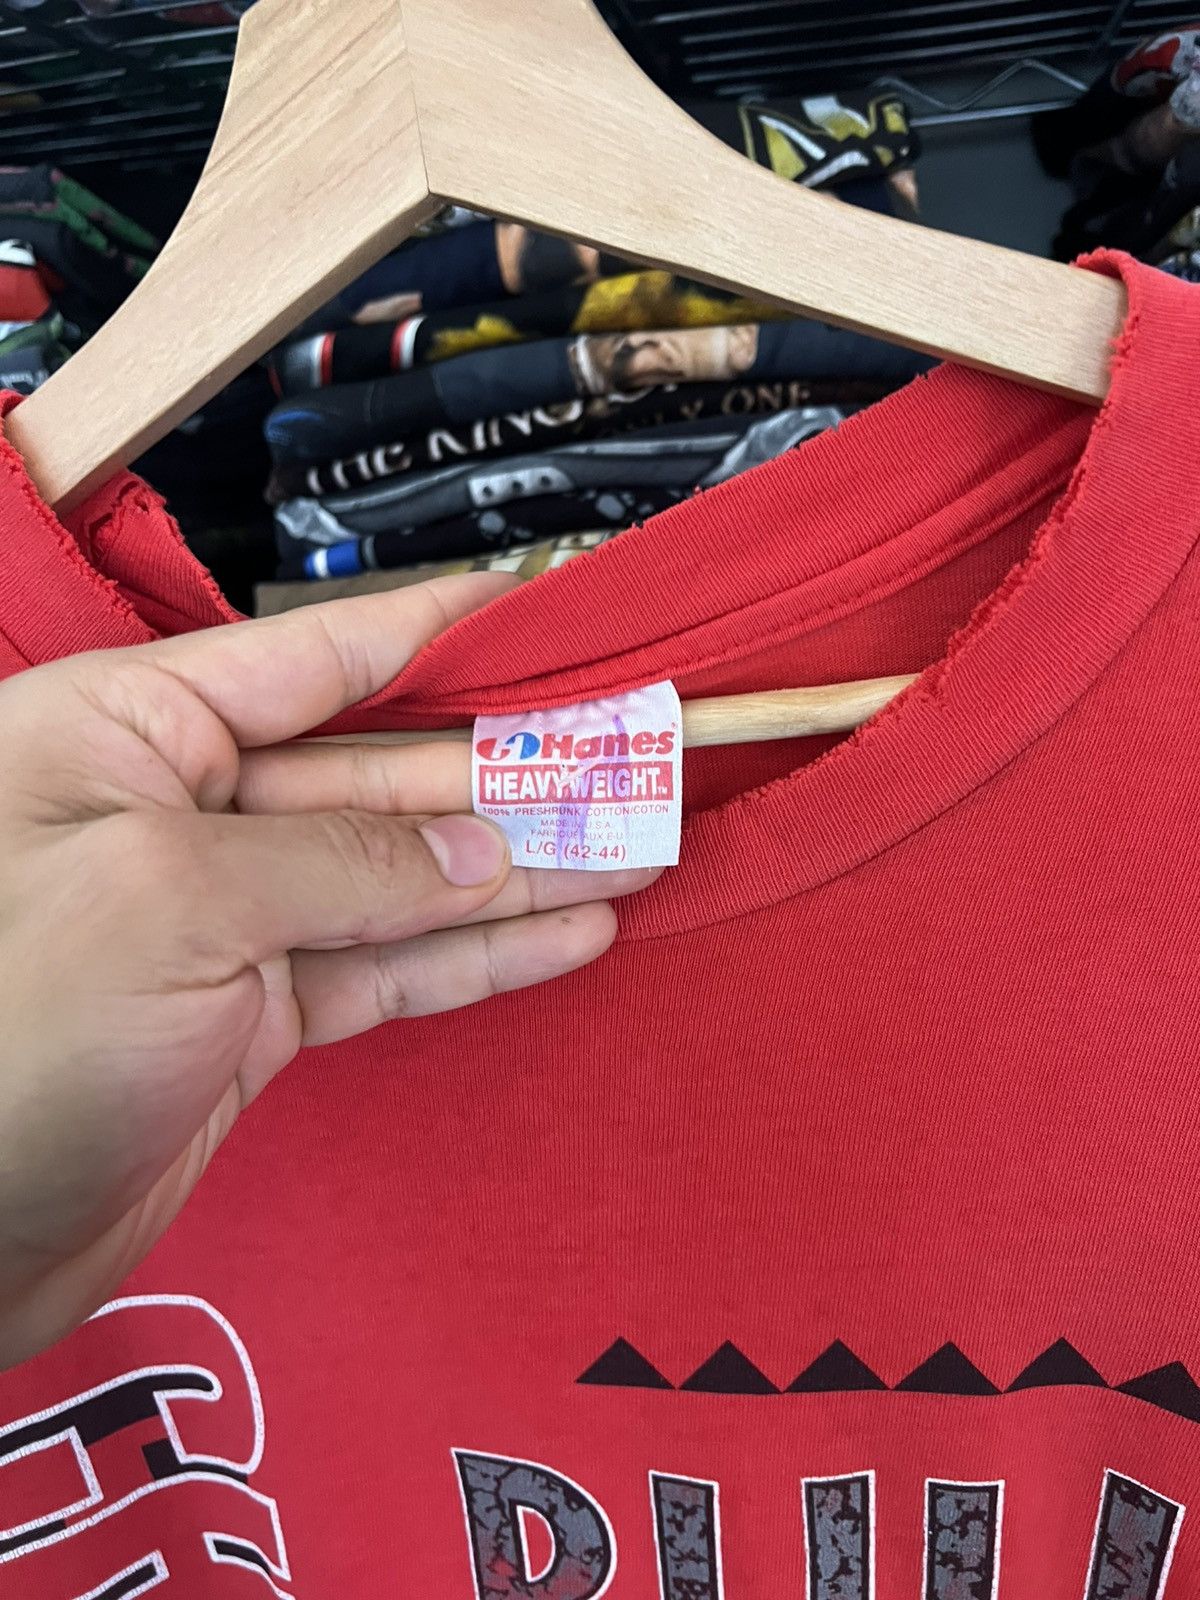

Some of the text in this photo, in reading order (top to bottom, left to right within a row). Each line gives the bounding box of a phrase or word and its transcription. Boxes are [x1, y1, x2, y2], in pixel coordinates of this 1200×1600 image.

[540, 730, 675, 761] Hanes
[484, 767, 660, 800] HEAVYWEIGHT
[482, 805, 669, 817] 100% PRESHRUNK COTTON/COTON
[540, 819, 567, 828] MADE
[584, 832, 604, 841] AUX
[525, 839, 626, 863] L/G (42-44)
